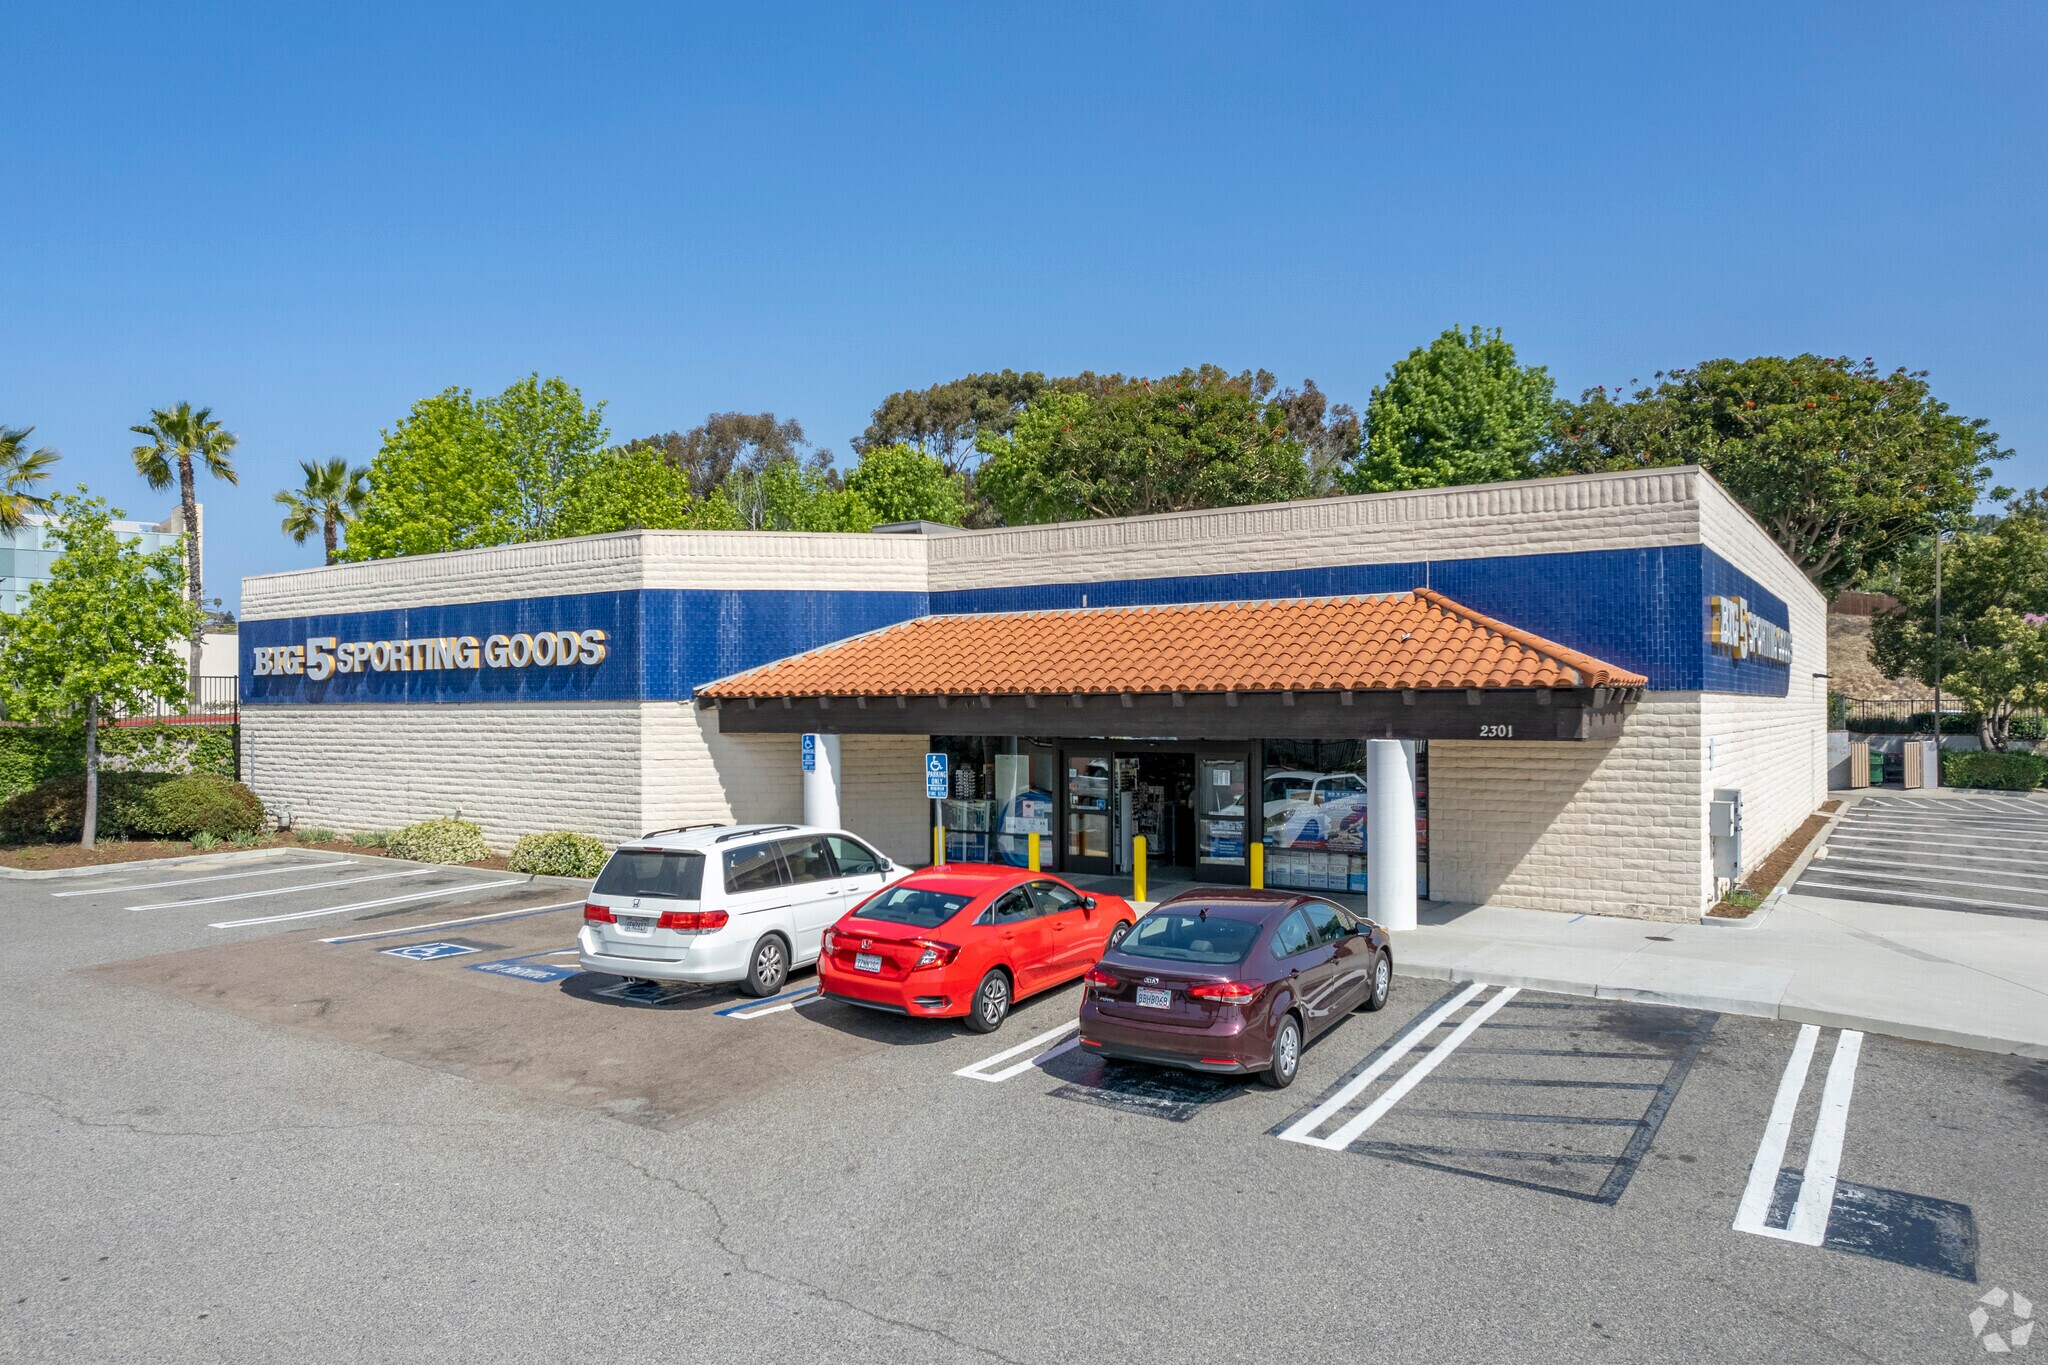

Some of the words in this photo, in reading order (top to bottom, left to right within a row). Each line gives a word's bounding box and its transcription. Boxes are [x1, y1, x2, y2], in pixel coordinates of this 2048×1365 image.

[253, 646, 304, 675] BIG
[306, 637, 336, 681] 5
[337, 636, 480, 673] SPORTING
[485, 629, 606, 668] GOODS
[1480, 725, 1513, 737] 2301
